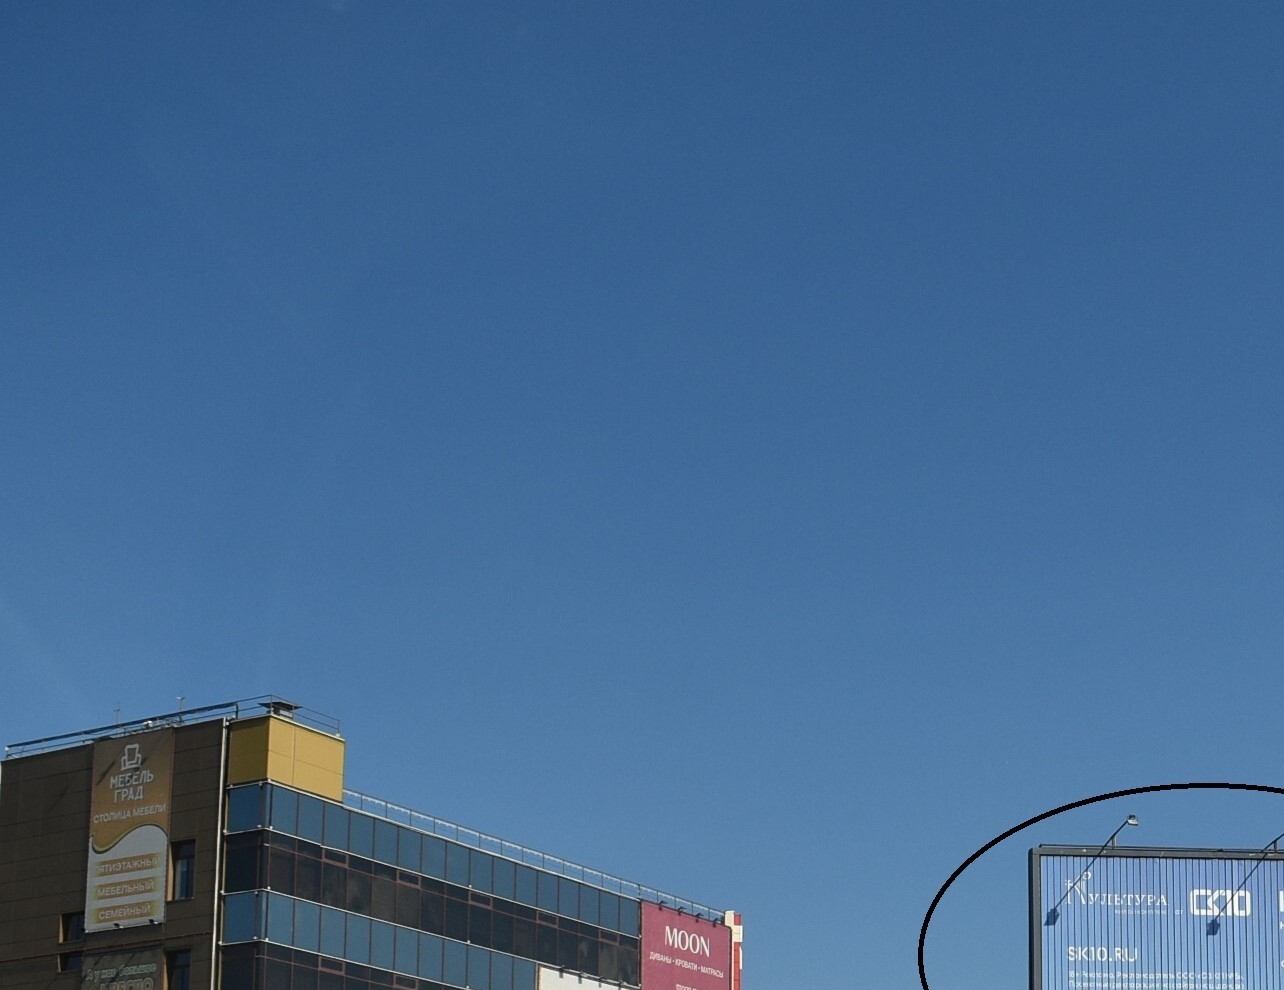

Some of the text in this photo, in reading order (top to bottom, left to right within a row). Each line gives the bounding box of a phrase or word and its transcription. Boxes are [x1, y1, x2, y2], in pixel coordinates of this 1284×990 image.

[110, 770, 154, 789] МЕБЕЛЬ
[114, 786, 144, 802] ГРАД
[94, 804, 166, 824] СТОЛИЦА МЕБЕЛИ
[98, 880, 154, 897] МЕБЕЛЬНЫЙ
[98, 903, 152, 920] СЕМЕЙНЫЙ
[664, 925, 711, 958] MOON
[1067, 946, 1138, 961] SK10.RU
[649, 951, 724, 978] ДИВАНЫ КРОВАТИ МАТРАСЫ
